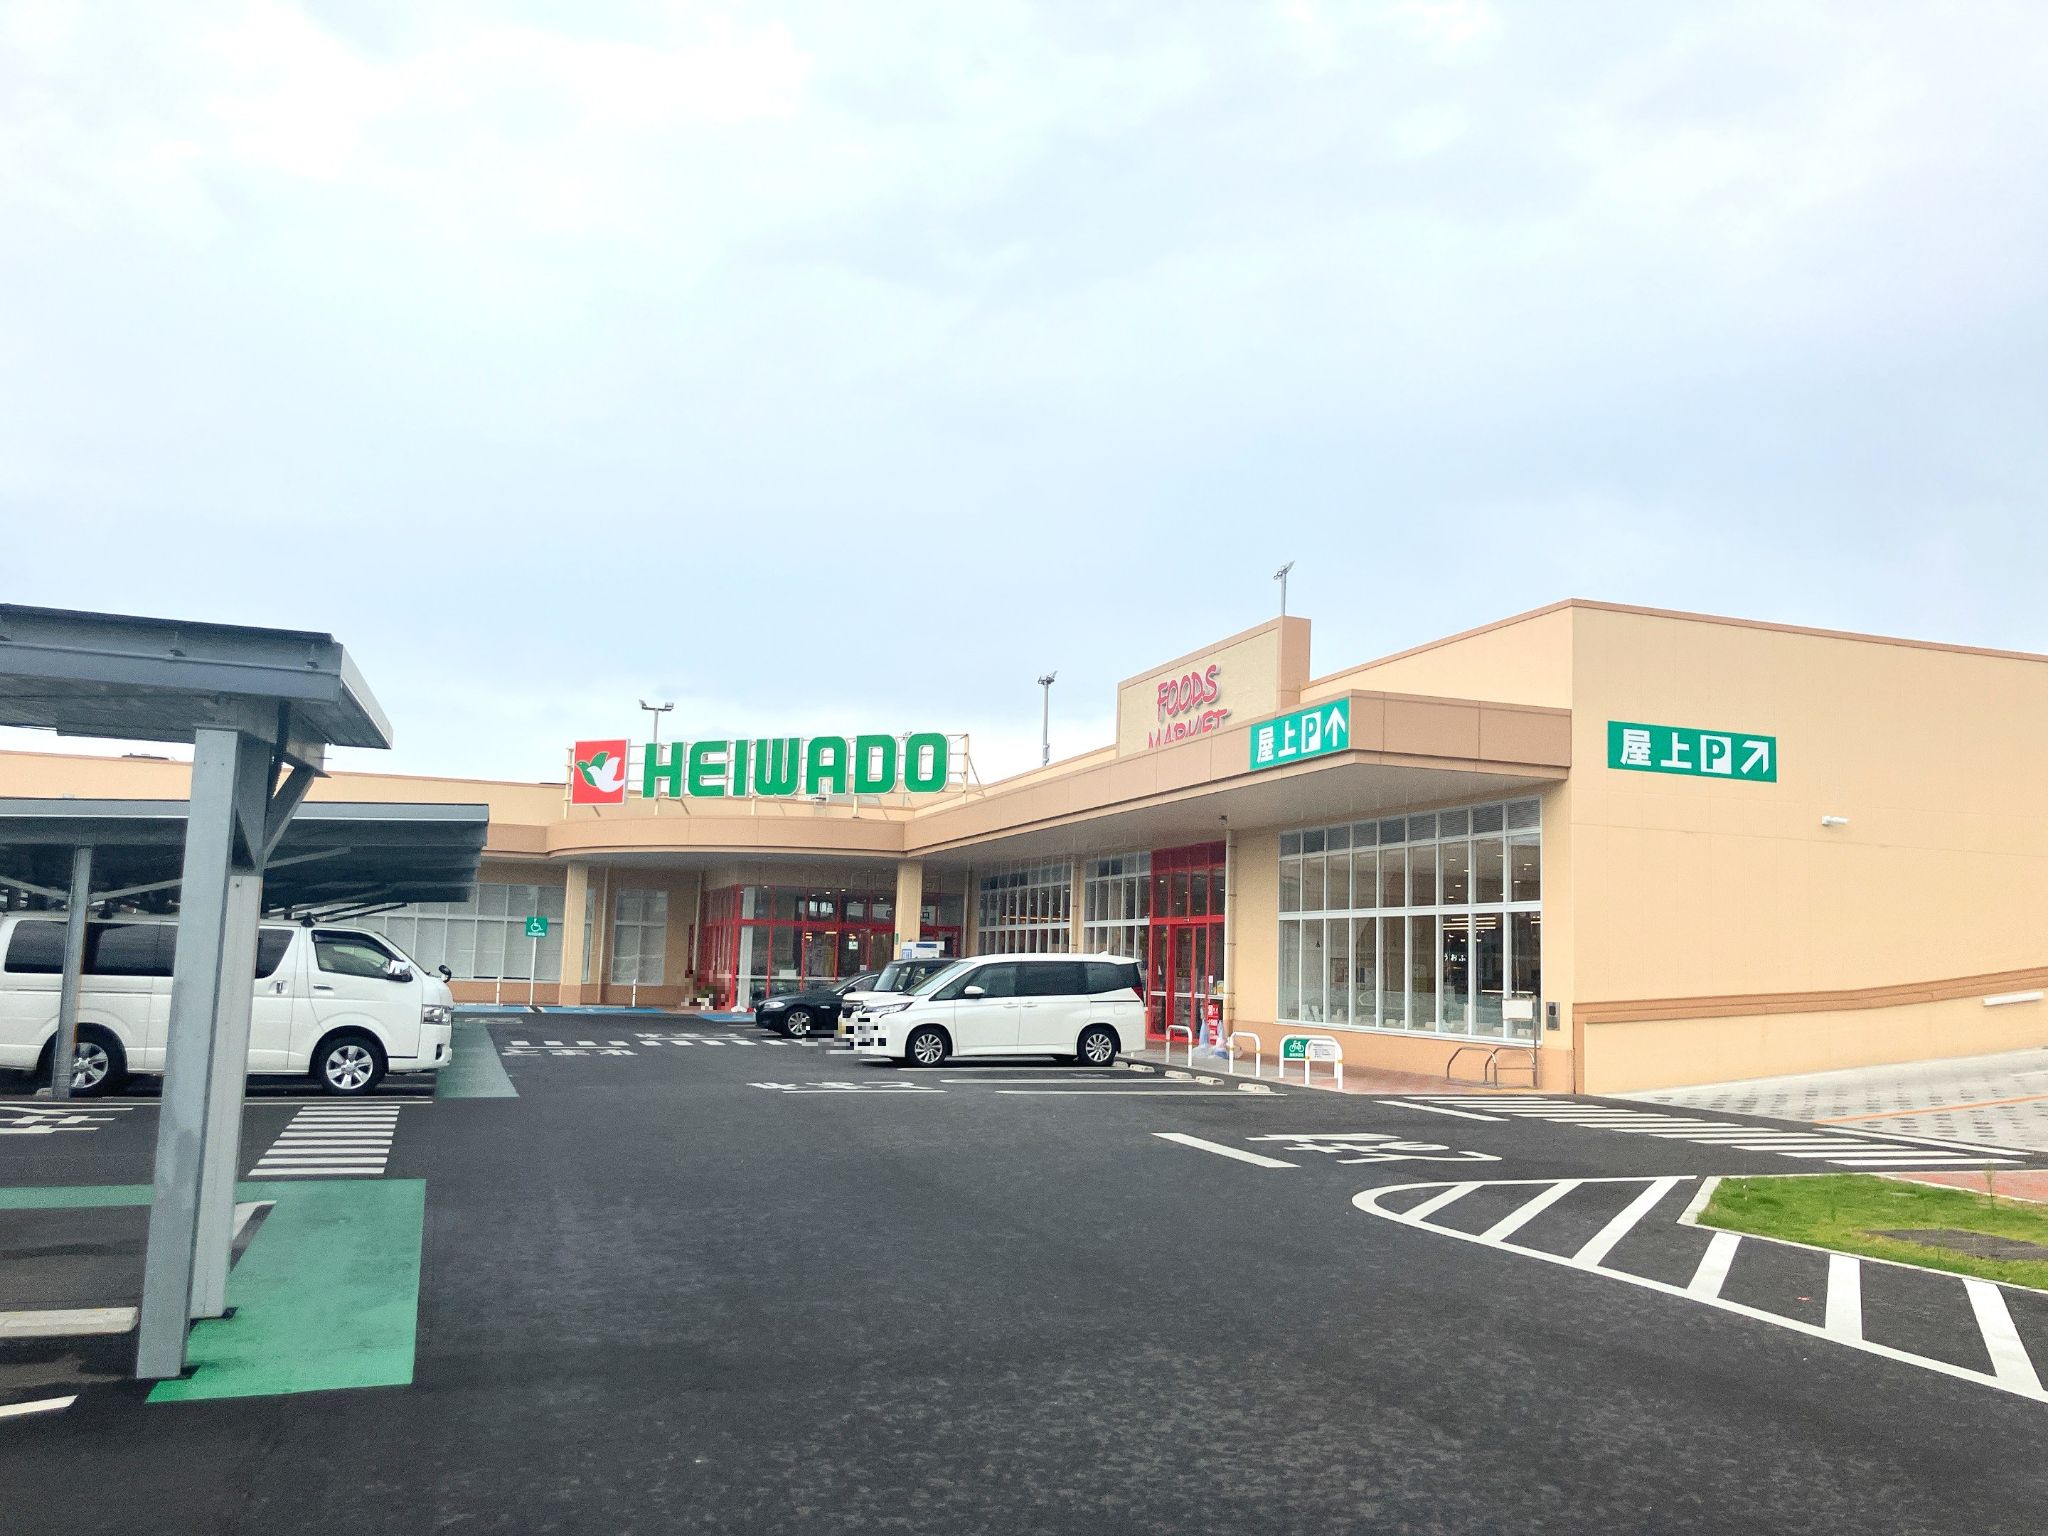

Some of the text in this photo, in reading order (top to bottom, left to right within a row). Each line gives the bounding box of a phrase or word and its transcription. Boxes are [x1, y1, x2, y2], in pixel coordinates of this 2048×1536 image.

[1157, 664, 1221, 721] FOODS
[642, 733, 949, 800] HEIWADO
[1245, 1133, 1502, 1165] とまれ
